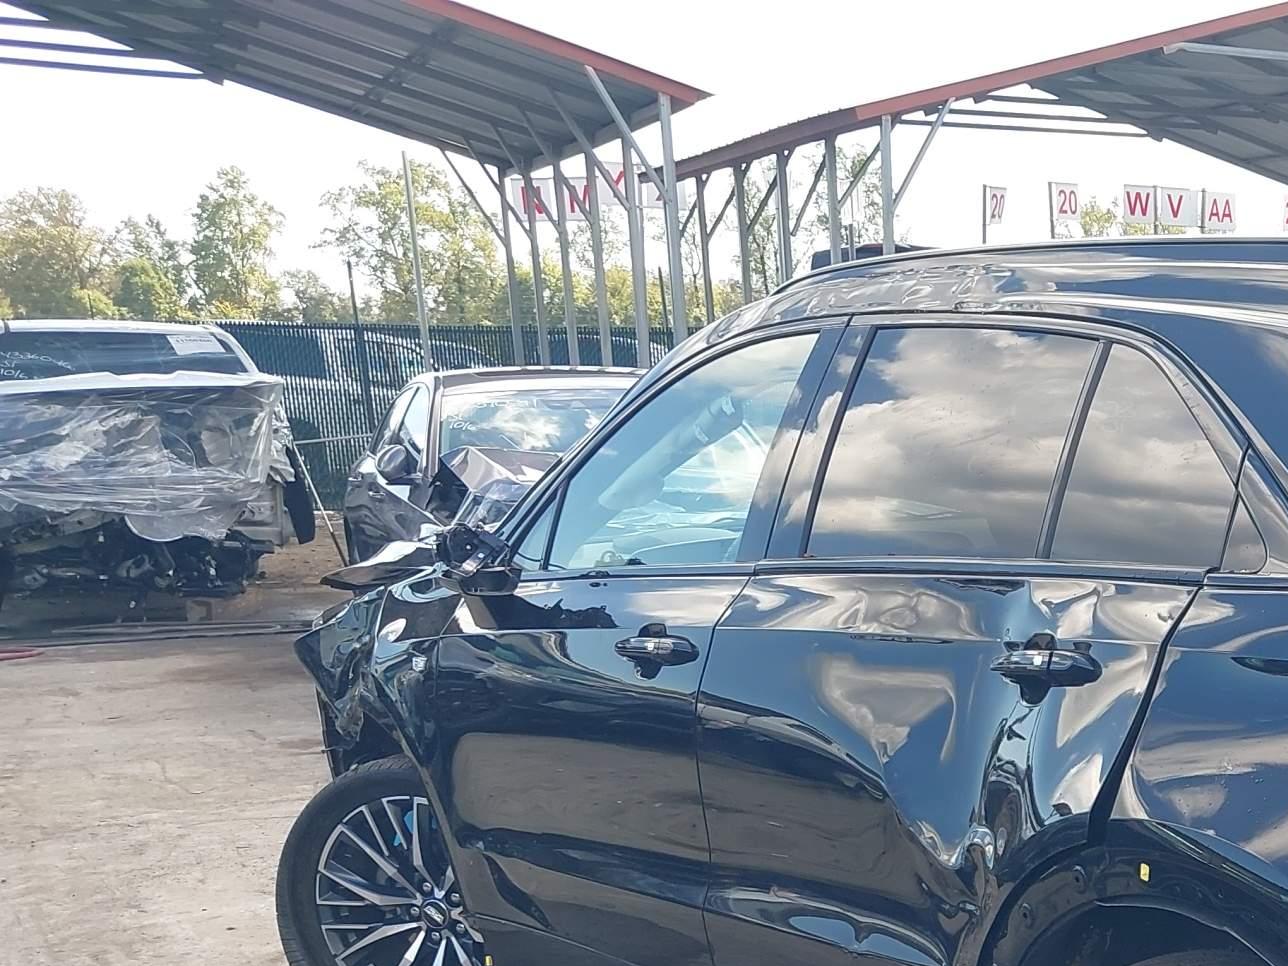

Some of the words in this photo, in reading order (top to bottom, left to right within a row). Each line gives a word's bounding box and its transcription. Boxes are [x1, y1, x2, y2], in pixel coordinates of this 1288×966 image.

[1058, 189, 1077, 215] 20
[1126, 191, 1150, 216] W
[1168, 193, 1183, 218] V
[1208, 198, 1233, 223] AA
